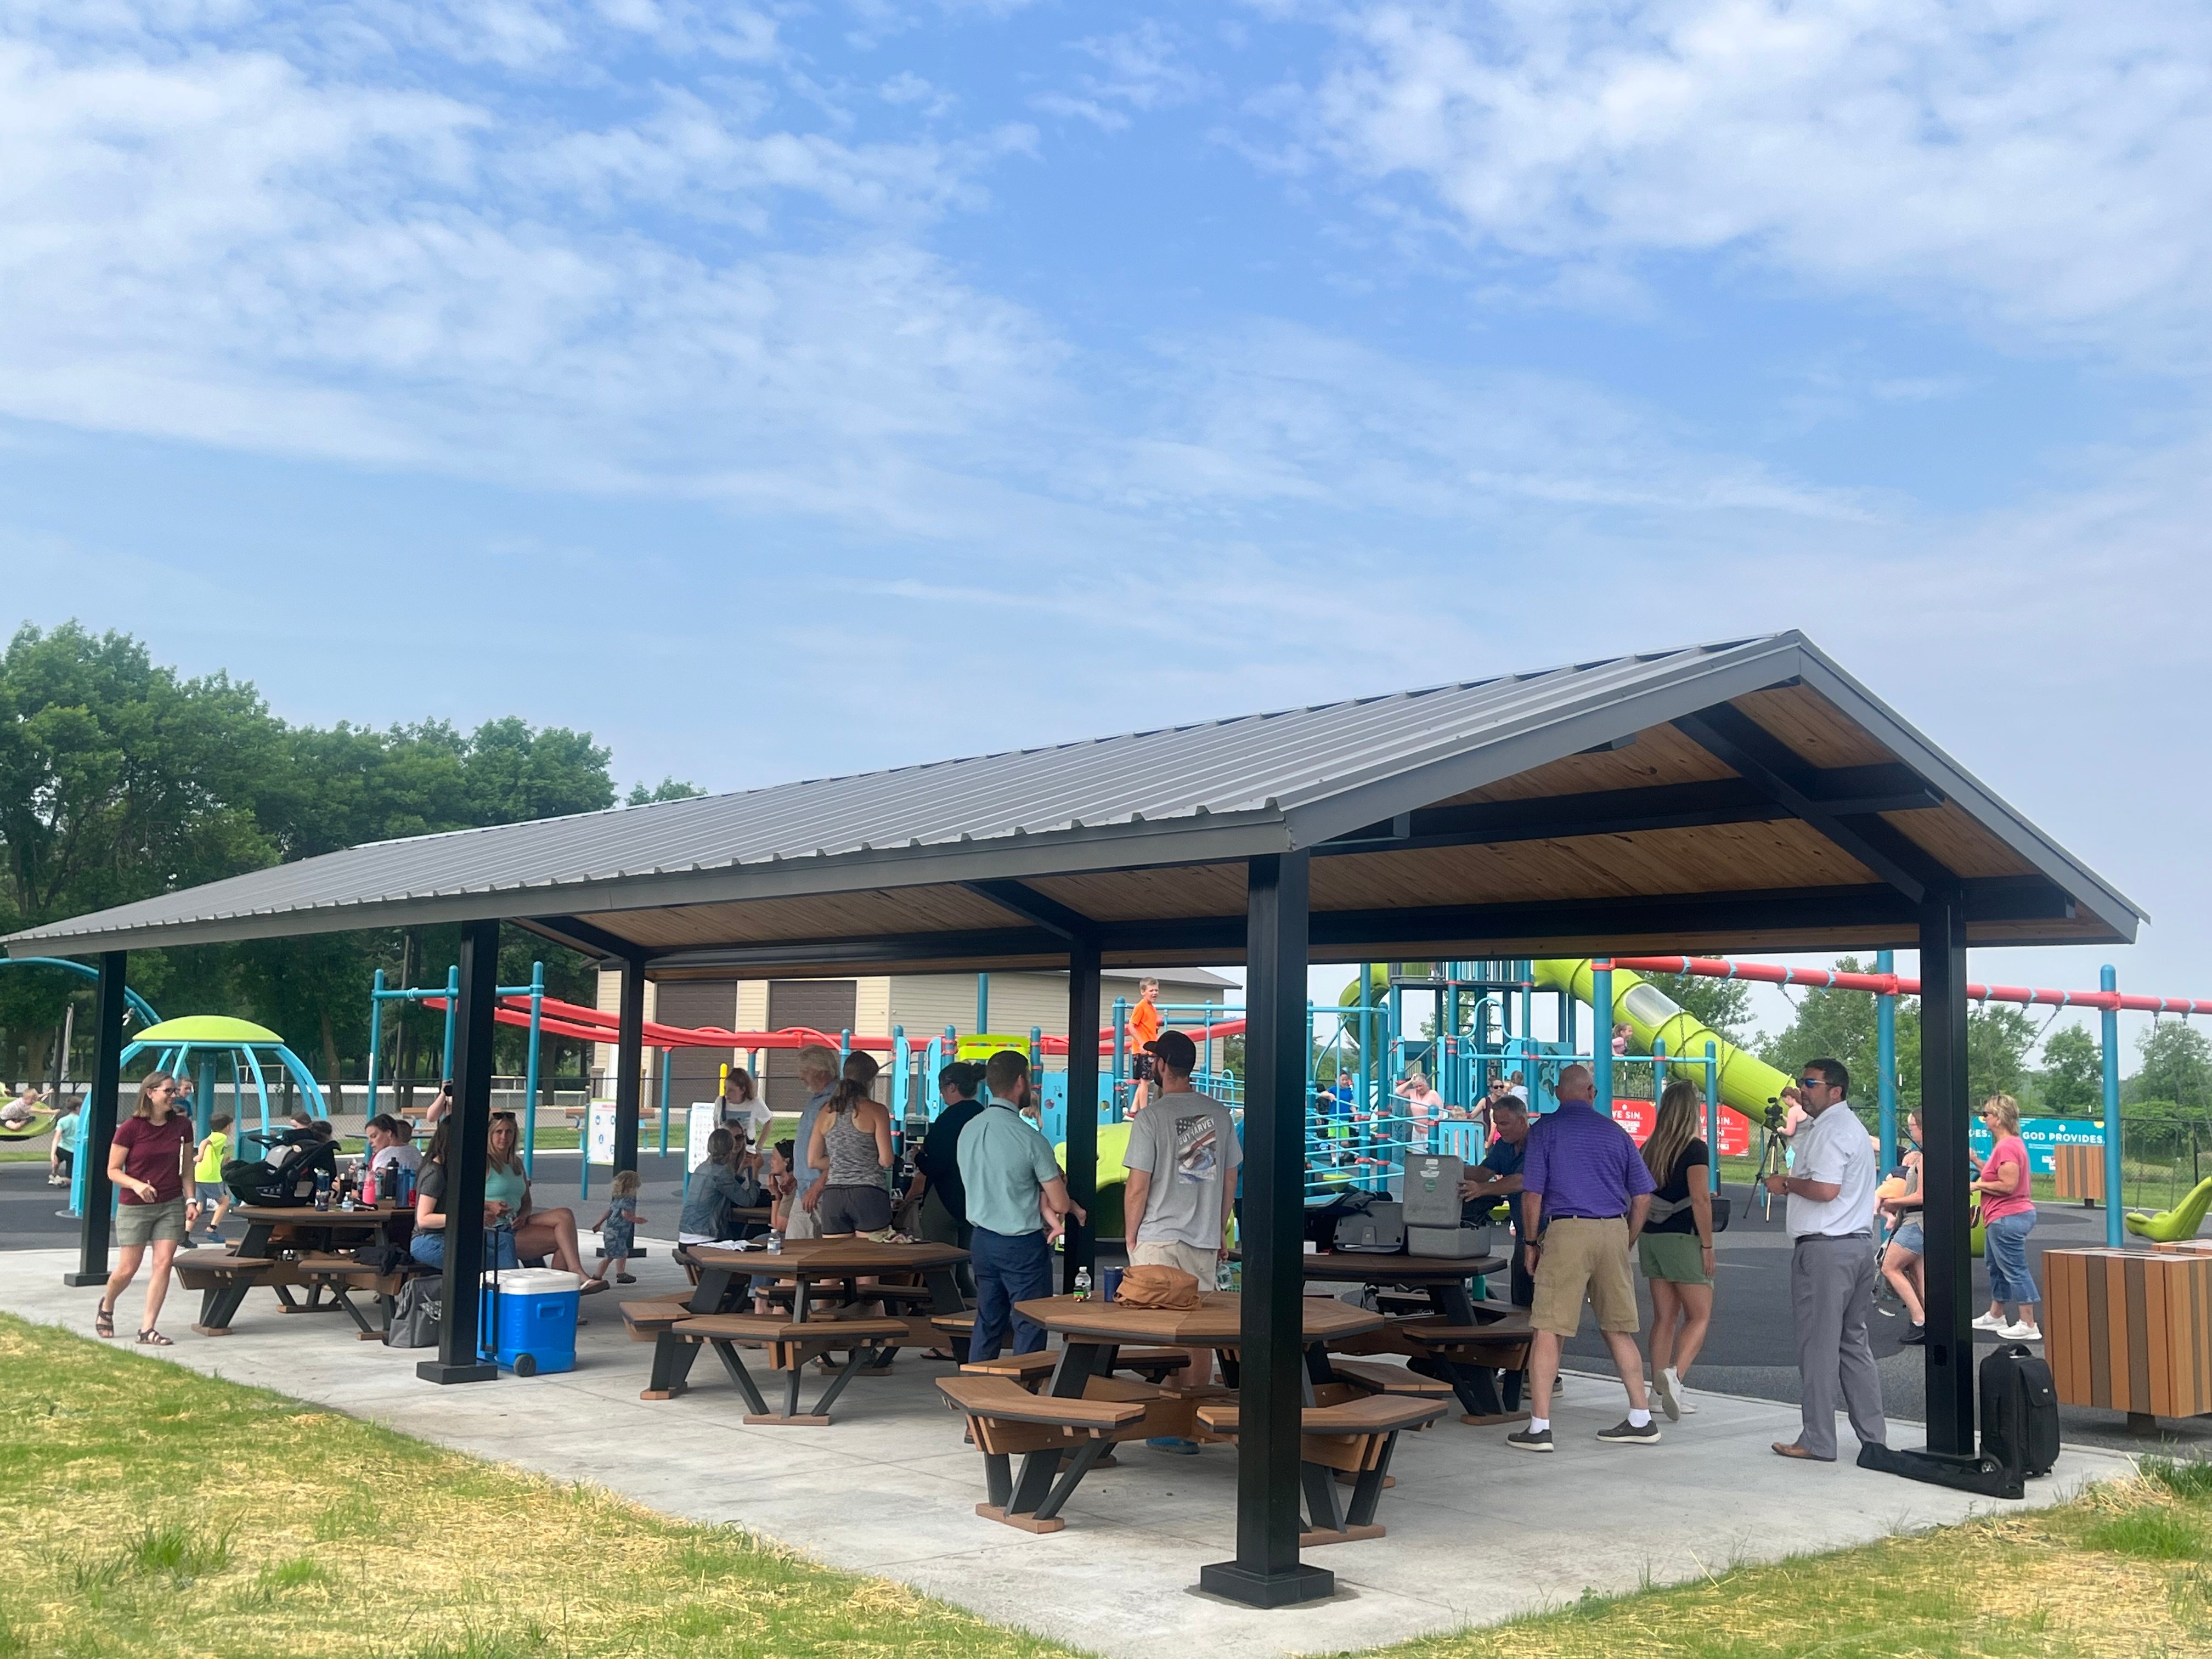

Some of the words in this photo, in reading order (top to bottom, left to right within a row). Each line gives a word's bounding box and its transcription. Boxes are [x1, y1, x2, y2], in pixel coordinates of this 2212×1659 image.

[1178, 1133, 1190, 1146] GUY
[1191, 1118, 1215, 1136] HARVEY
[2022, 1131, 2046, 1141] GOD
